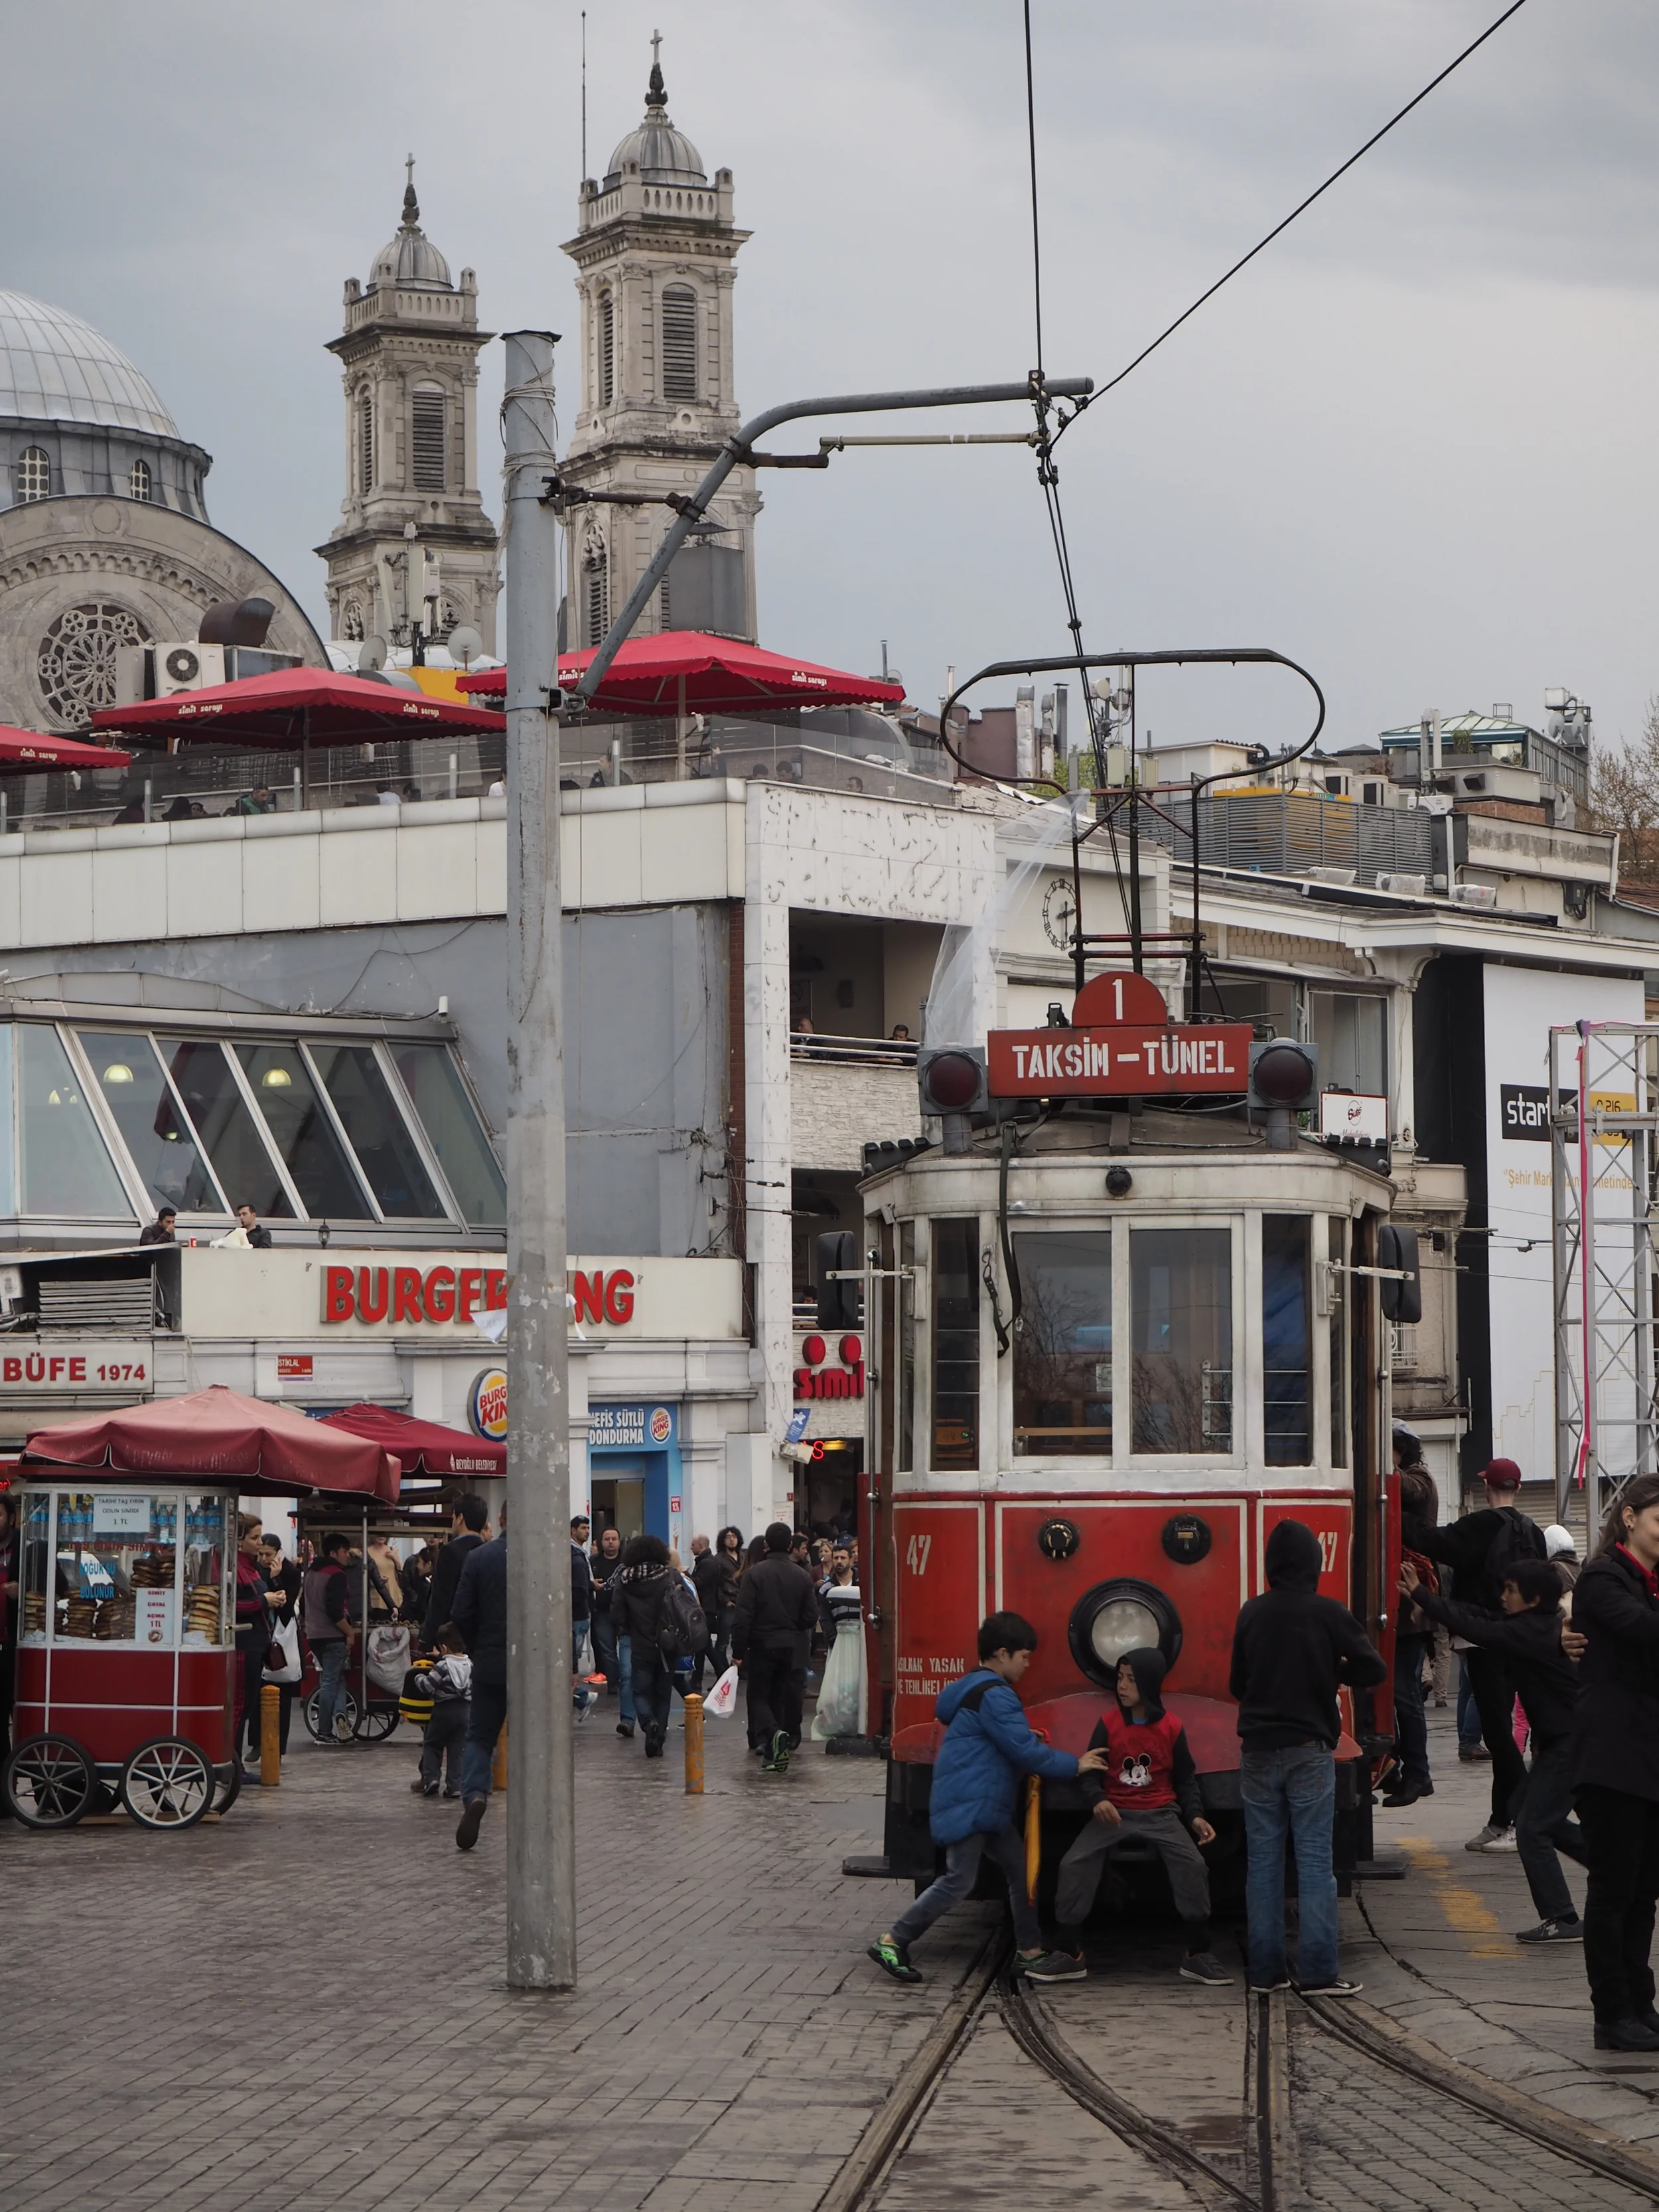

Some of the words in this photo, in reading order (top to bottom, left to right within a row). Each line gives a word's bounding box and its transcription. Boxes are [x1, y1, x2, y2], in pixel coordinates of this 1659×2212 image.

[559, 669, 578, 680] simit
[792, 671, 807, 682] simit
[178, 705, 196, 714] simit
[403, 703, 418, 713] simit
[20, 748, 36, 757] simit
[1112, 979, 1123, 1020] 1
[1012, 1037, 1109, 1078] TAKSİM
[1143, 1035, 1235, 1075] TÜNEL
[321, 1266, 507, 1325] BURGER
[575, 1269, 634, 1325] NG
[3, 1353, 86, 1382] BÜFE
[97, 1364, 145, 1380] 1974
[480, 1386, 506, 1410] BURG
[481, 1401, 508, 1426] KIN
[616, 1408, 644, 1427] SÜTLÜ
[652, 1414, 668, 1427] BURGER
[589, 1428, 644, 1444] DONDURMA
[653, 1420, 669, 1436] KING
[906, 1534, 932, 1575] 47
[930, 1658, 964, 1672] YASAK
